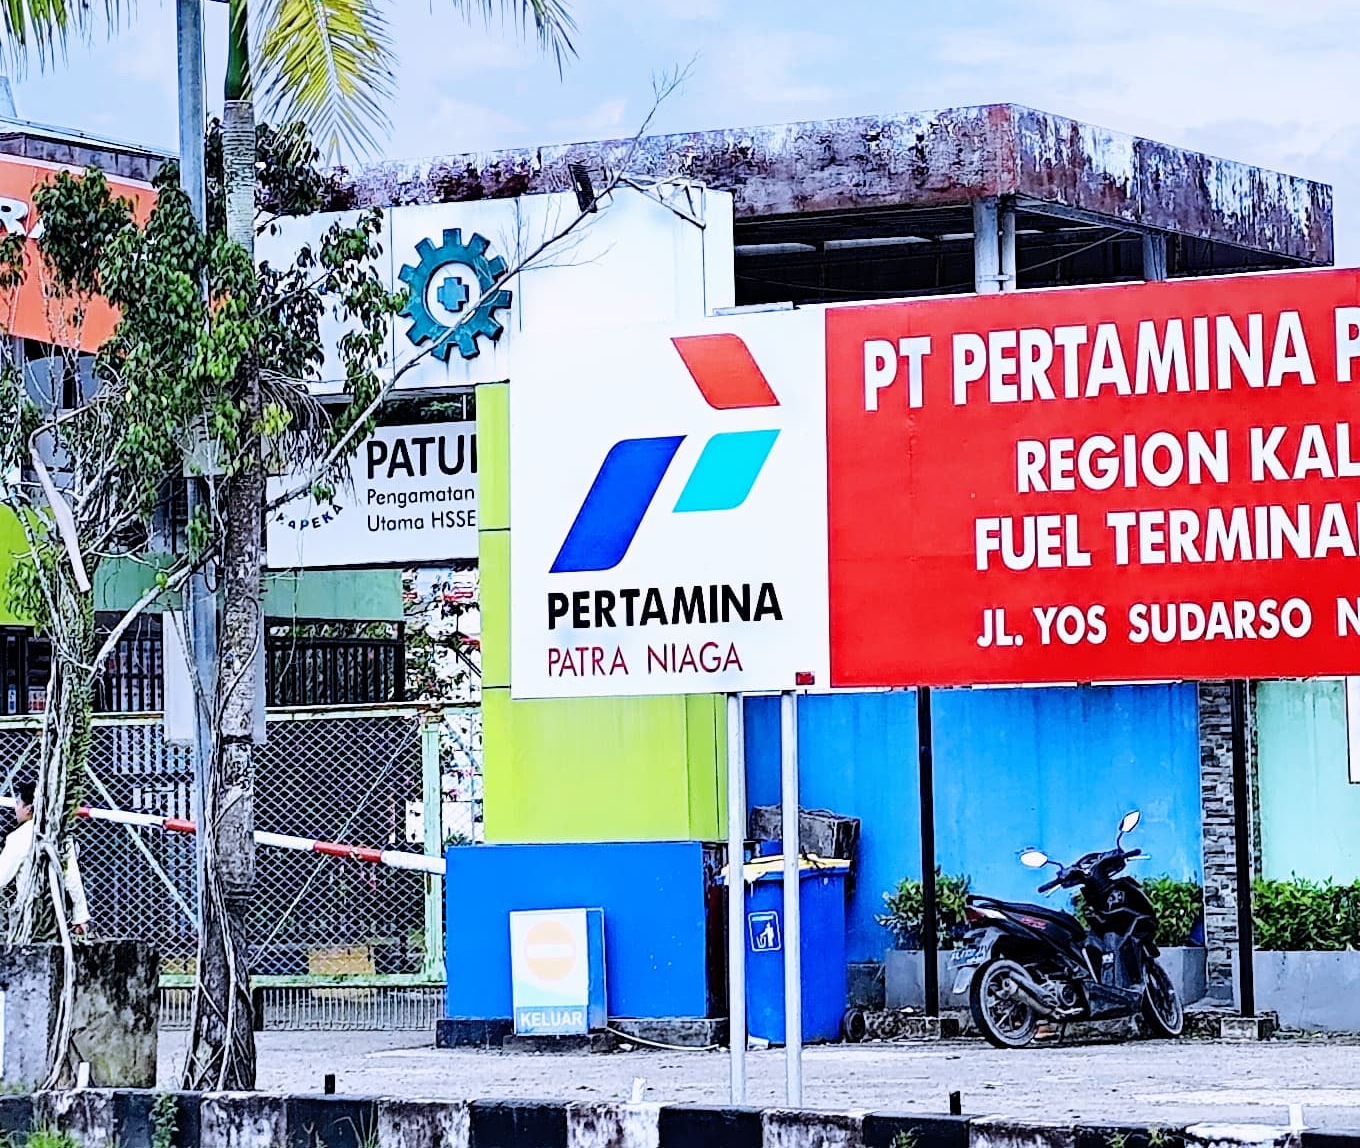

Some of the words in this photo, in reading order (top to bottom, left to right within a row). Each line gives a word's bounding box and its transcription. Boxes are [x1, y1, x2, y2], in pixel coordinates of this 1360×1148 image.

[863, 336, 932, 412] PT
[952, 311, 1316, 405] PERTAMINA
[367, 434, 478, 479] PATU
[1017, 429, 1229, 494] REGION
[368, 487, 475, 508] Pengamatan
[368, 515, 424, 531] Utama
[432, 510, 476, 528] HSSE
[975, 514, 1091, 572] FUEL
[547, 582, 783, 630] PERTAMINA
[977, 609, 1023, 647] JL.
[1033, 605, 1107, 645] YOS
[1128, 597, 1312, 644] SUDARSO
[547, 643, 629, 677] PATRA
[648, 641, 743, 672] NIAGA
[521, 1011, 584, 1028] KELUAR
